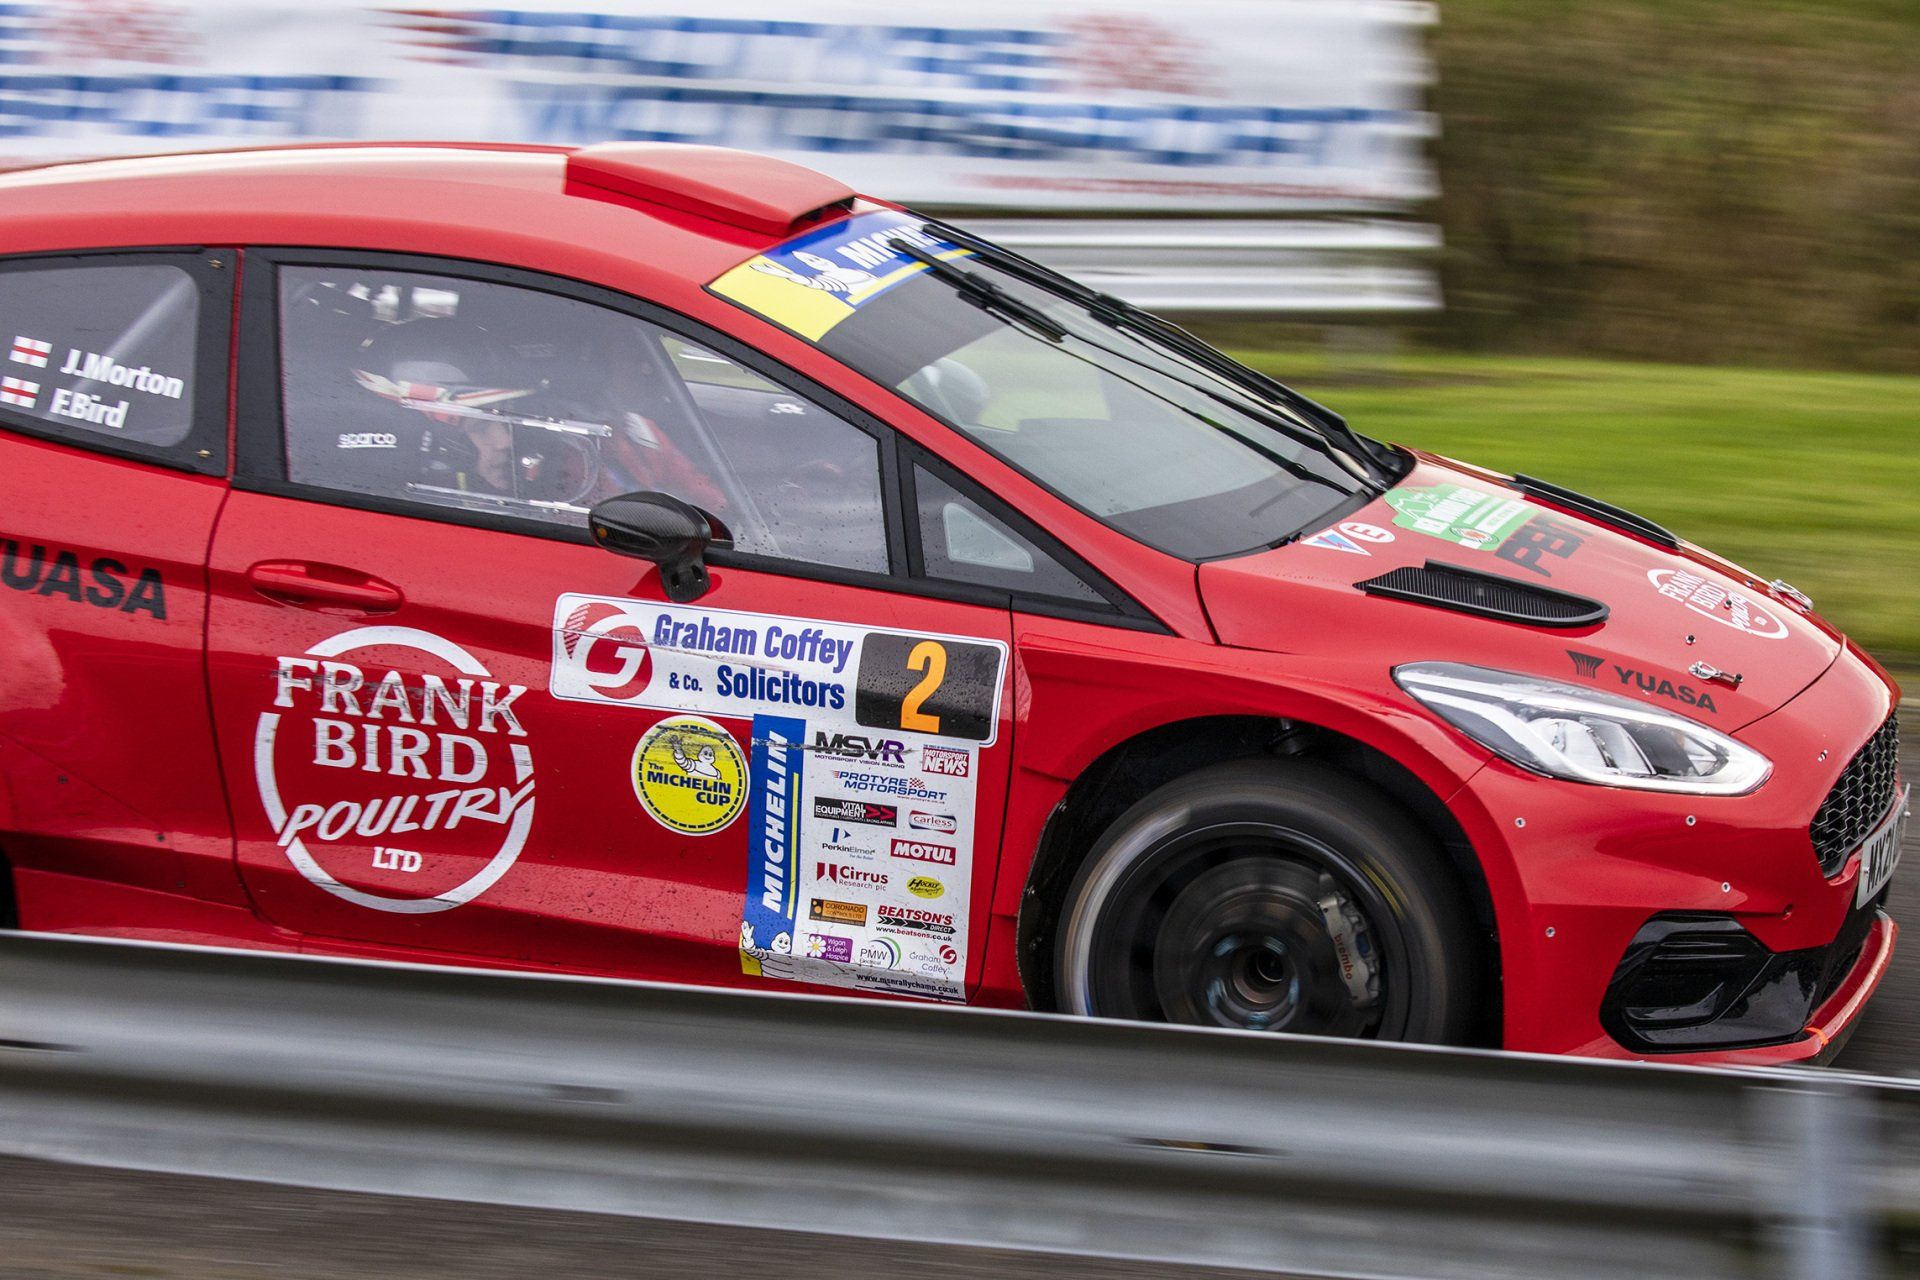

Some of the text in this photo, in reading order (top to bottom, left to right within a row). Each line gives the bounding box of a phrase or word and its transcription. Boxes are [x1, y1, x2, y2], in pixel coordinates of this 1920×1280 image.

[60, 348, 184, 399] J.Morton
[338, 432, 397, 447] sparco
[0, 538, 168, 622] UASA
[653, 613, 854, 672] Graham Coffey
[669, 665, 845, 710] & Co. Solicitors
[900, 640, 948, 733] 2
[1614, 664, 1718, 714] YUASA
[273, 655, 528, 737] FRANK
[311, 717, 489, 784] BIRD
[815, 731, 905, 764] MSVR
[924, 749, 968, 761] MOTORSPORT
[648, 762, 664, 771] The
[814, 754, 857, 763] MOTORSPORT
[923, 756, 968, 776] NEWS
[647, 771, 732, 795] MICHELIN
[839, 771, 908, 787] PROTYRE
[696, 791, 731, 807] CUP
[844, 780, 947, 800] MOTORSPORT
[276, 780, 536, 847] POULTRY
[815, 805, 866, 818] EQUIPMENT
[842, 802, 865, 811] VITAL
[762, 730, 788, 914] MICHELIN
[913, 815, 952, 828] carless
[371, 846, 423, 873] LTD
[894, 842, 953, 863] MOTUL
[839, 865, 889, 885] Cirrus
[839, 879, 873, 891] Research
[825, 902, 865, 913] CORONADO
[877, 905, 953, 926] BEATSON'S
[875, 926, 953, 942] www.beatsons.co.uk
[929, 924, 952, 933] DIRECT
[827, 938, 846, 947] Wigan
[833, 946, 848, 954] Leigh
[825, 952, 849, 962] Hospice
[860, 948, 888, 960] PMW
[909, 951, 941, 963] Graham
[1334, 933, 1353, 980] brembo
[921, 961, 949, 974] Coffey
